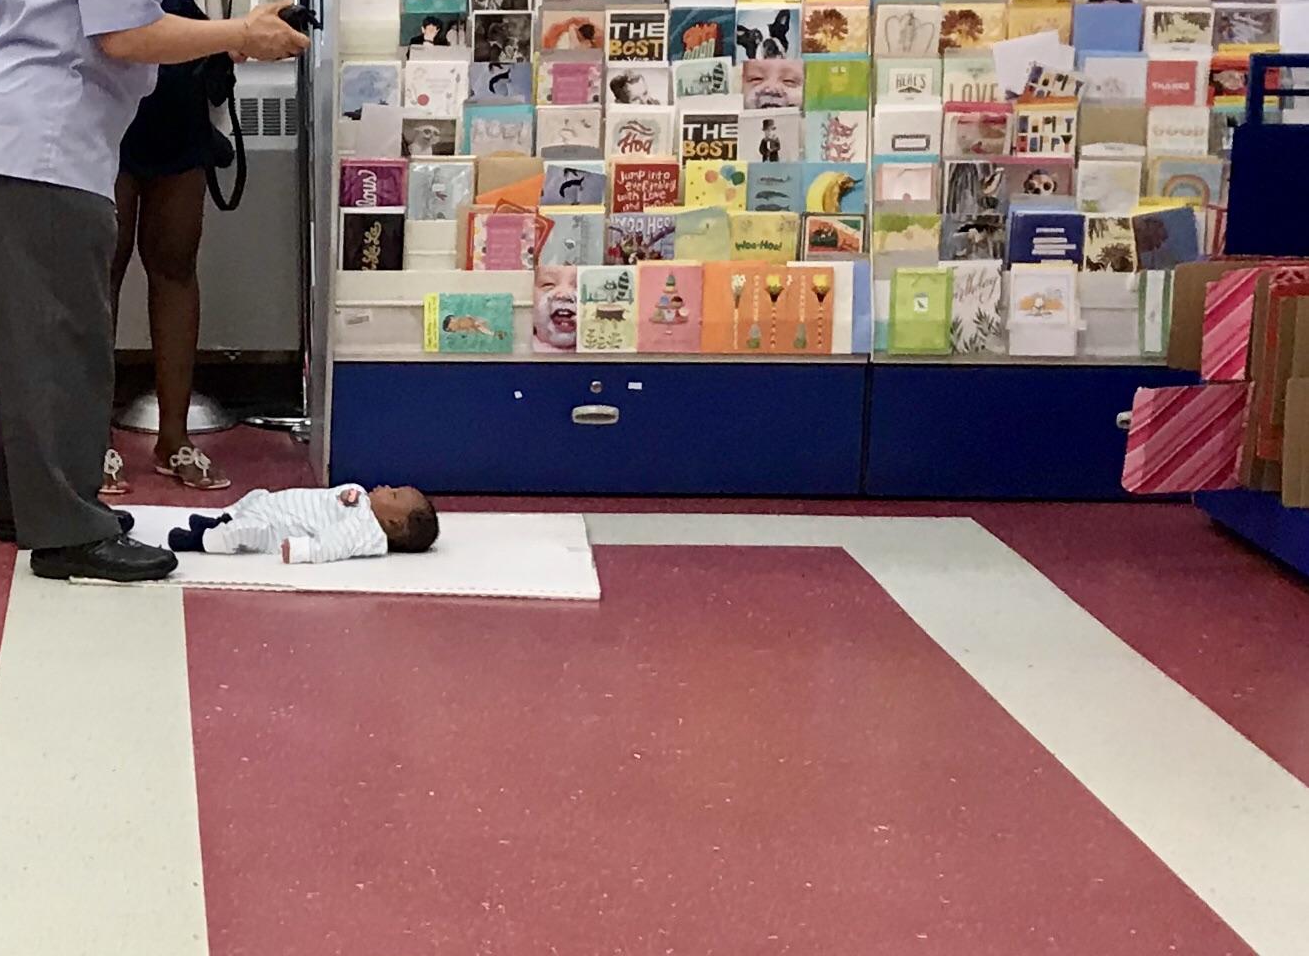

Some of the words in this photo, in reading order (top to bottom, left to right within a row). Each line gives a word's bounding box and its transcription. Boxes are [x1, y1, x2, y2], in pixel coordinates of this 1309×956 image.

[609, 22, 665, 40] THE
[683, 123, 738, 140] THE
[617, 170, 646, 185] Jump
[648, 170, 671, 180] into
[617, 191, 640, 202] with
